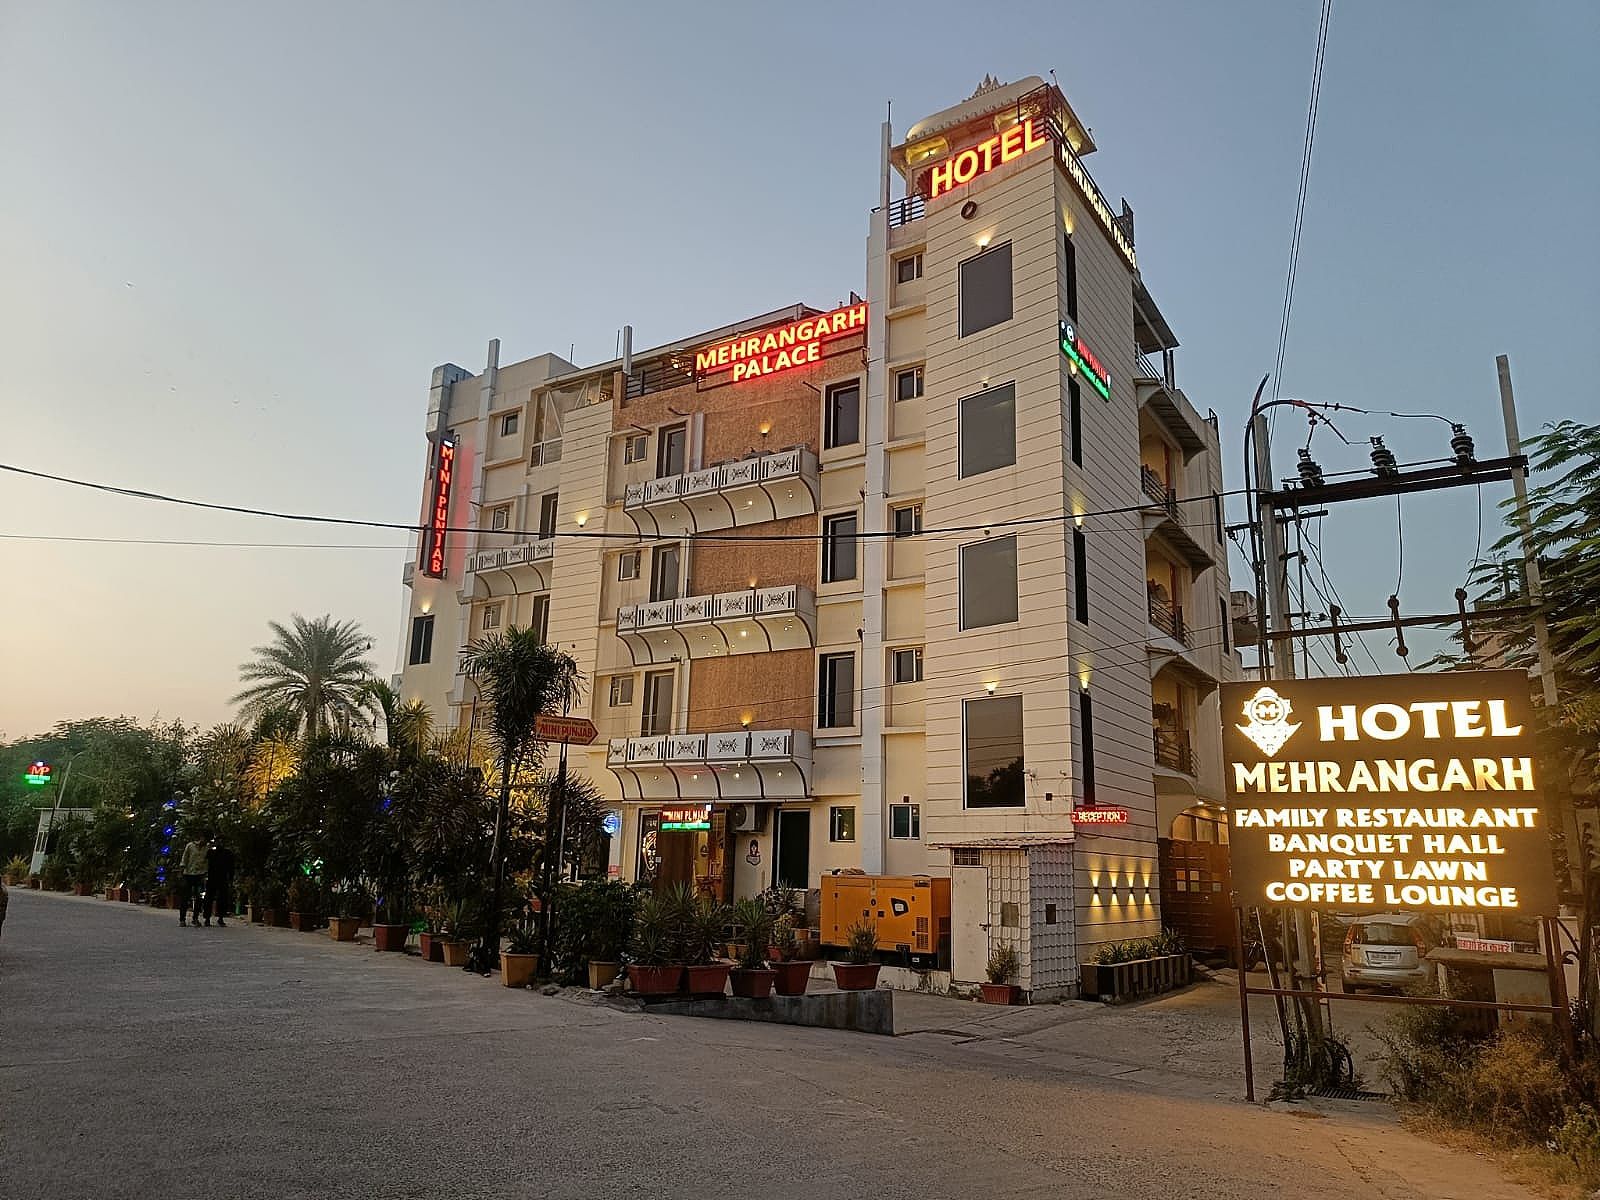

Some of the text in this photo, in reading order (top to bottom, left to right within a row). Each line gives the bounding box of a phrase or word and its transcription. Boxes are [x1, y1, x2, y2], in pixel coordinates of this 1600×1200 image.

[931, 119, 1046, 198] HOTEL
[695, 305, 866, 382] MEHRANGARH PALACE
[1316, 699, 1523, 742] HOTEL
[1232, 757, 1537, 794] MEHRANGARH
[1078, 811, 1121, 821] RECEPTION
[1235, 807, 1539, 828] FAMILY RESTAURANT
[1268, 833, 1505, 856] BANQUET HALL
[1288, 858, 1488, 882] PARTY LAWN
[1265, 881, 1519, 908] COFFEE LOUNGE
